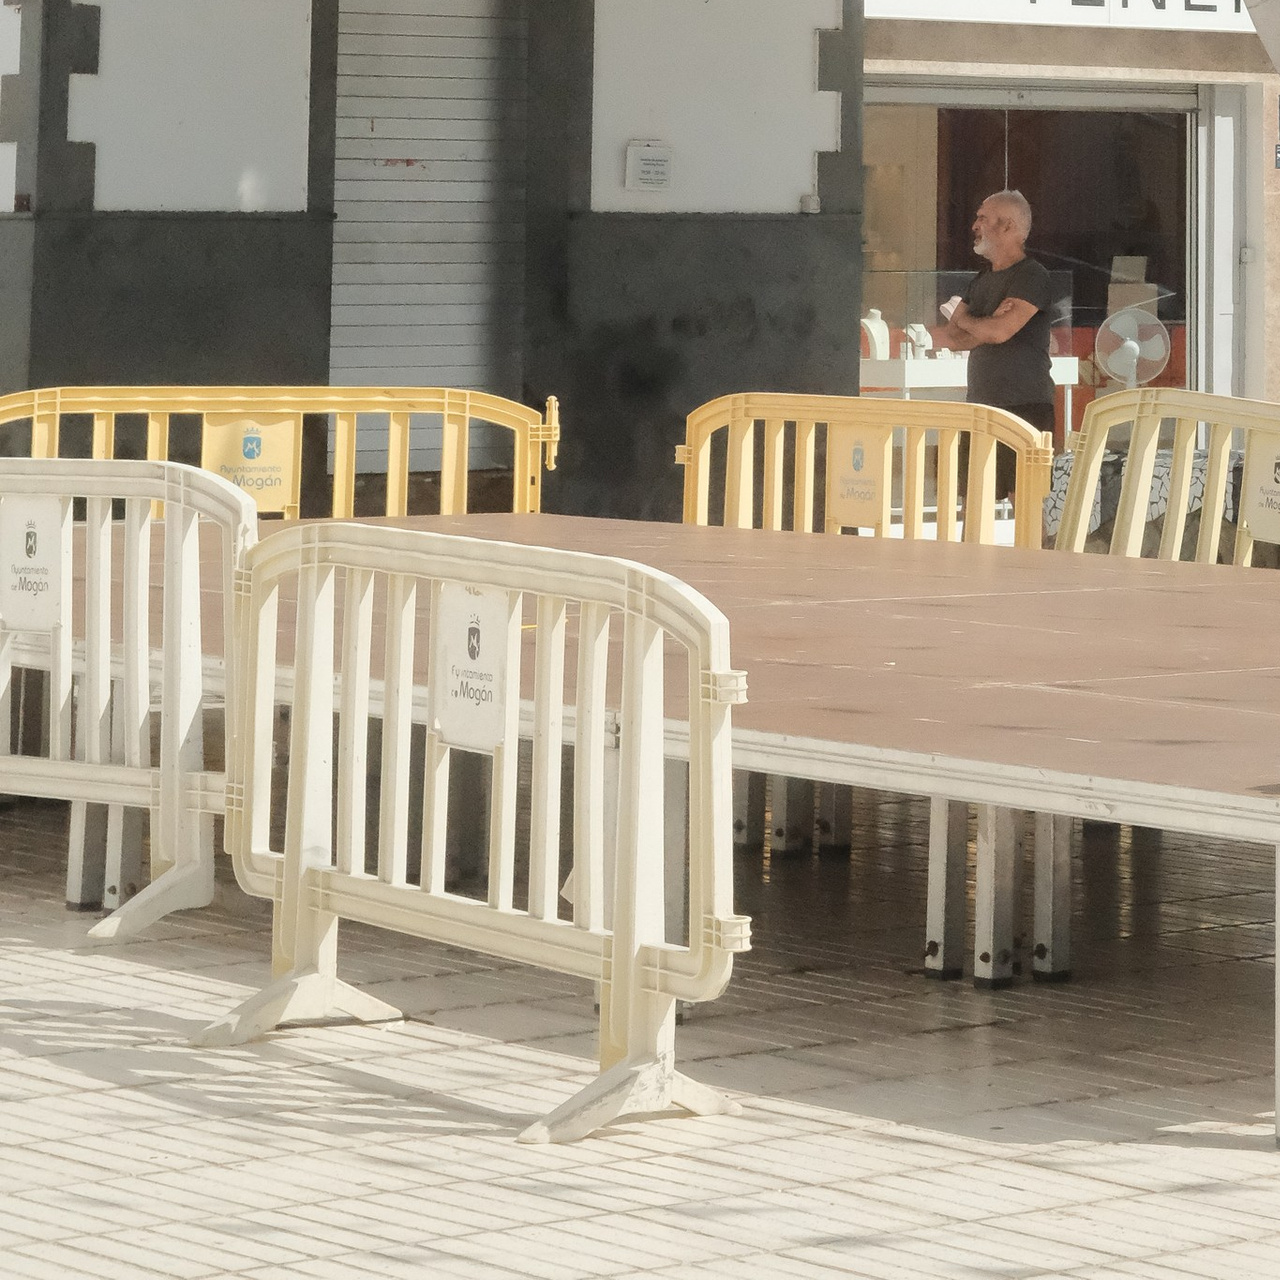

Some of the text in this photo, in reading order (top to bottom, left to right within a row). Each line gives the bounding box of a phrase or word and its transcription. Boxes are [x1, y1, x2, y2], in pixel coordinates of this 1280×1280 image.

[219, 464, 282, 476] Ayuntamiento
[232, 473, 282, 490] Mogán
[18, 576, 49, 596] Mogán
[459, 680, 493, 707] Mogán
